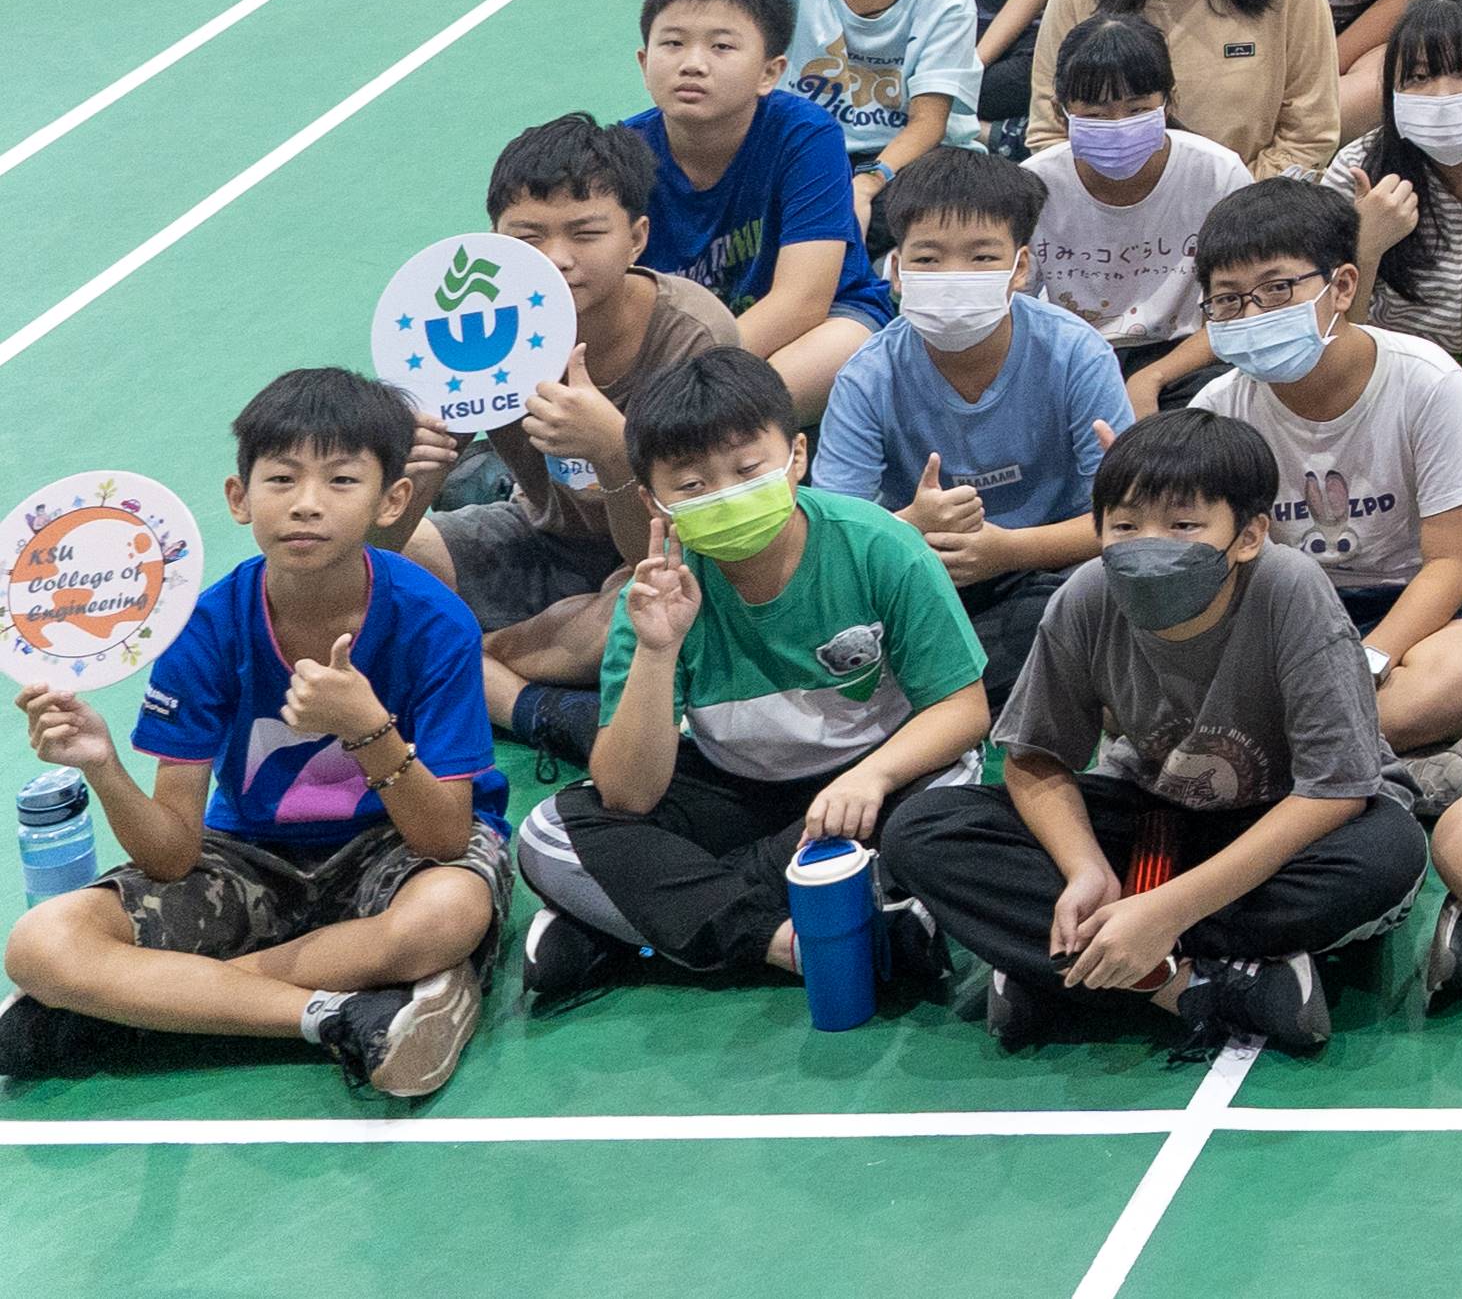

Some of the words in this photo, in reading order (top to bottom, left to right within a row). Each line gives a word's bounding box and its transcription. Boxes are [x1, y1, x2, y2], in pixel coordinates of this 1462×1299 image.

[1036, 237, 1172, 265] すみっコぐらし
[440, 397, 485, 421] KSU
[491, 392, 521, 412] CE
[1348, 493, 1396, 519] ZPD
[28, 544, 74, 565] KSU
[28, 567, 117, 595] College
[121, 562, 145, 582] of
[26, 593, 149, 623] Engineering
